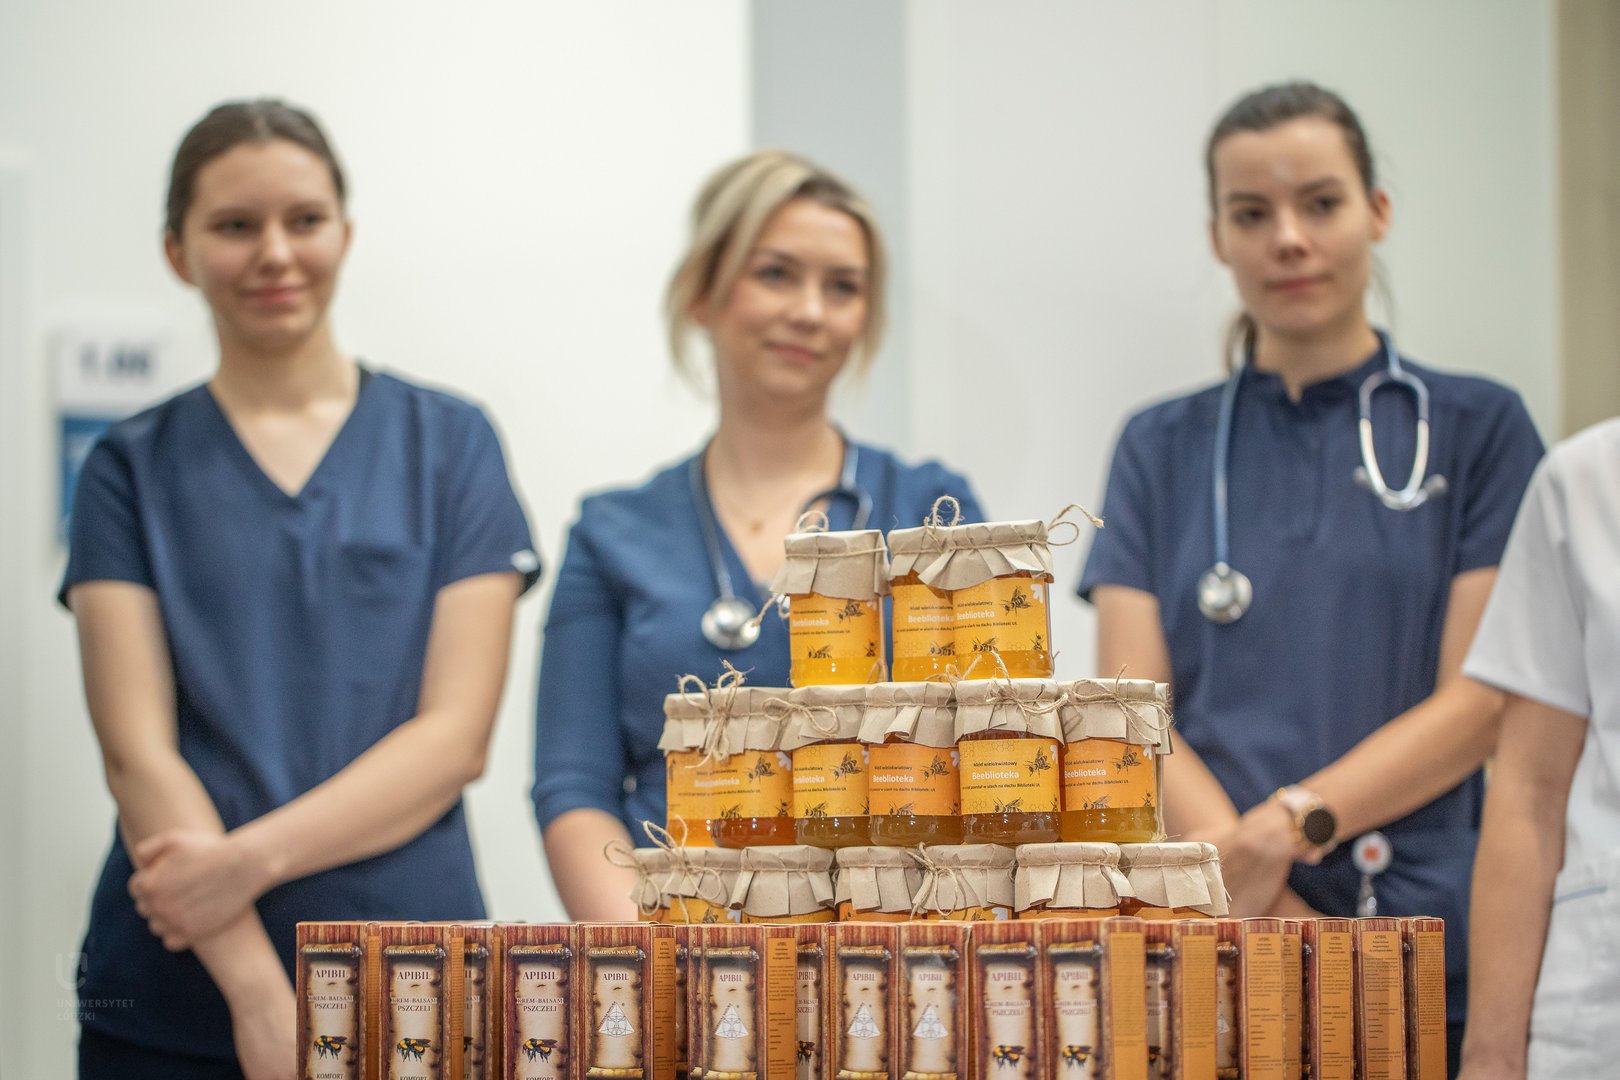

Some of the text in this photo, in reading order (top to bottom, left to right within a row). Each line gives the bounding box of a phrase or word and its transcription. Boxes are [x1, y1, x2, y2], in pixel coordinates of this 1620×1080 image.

[873, 774, 914, 783] Beeblioteka
[972, 771, 1020, 780] Beeblioteka
[314, 969, 348, 978] APIBIL
[397, 971, 432, 980] APIBIL
[523, 971, 558, 980] APIBIL
